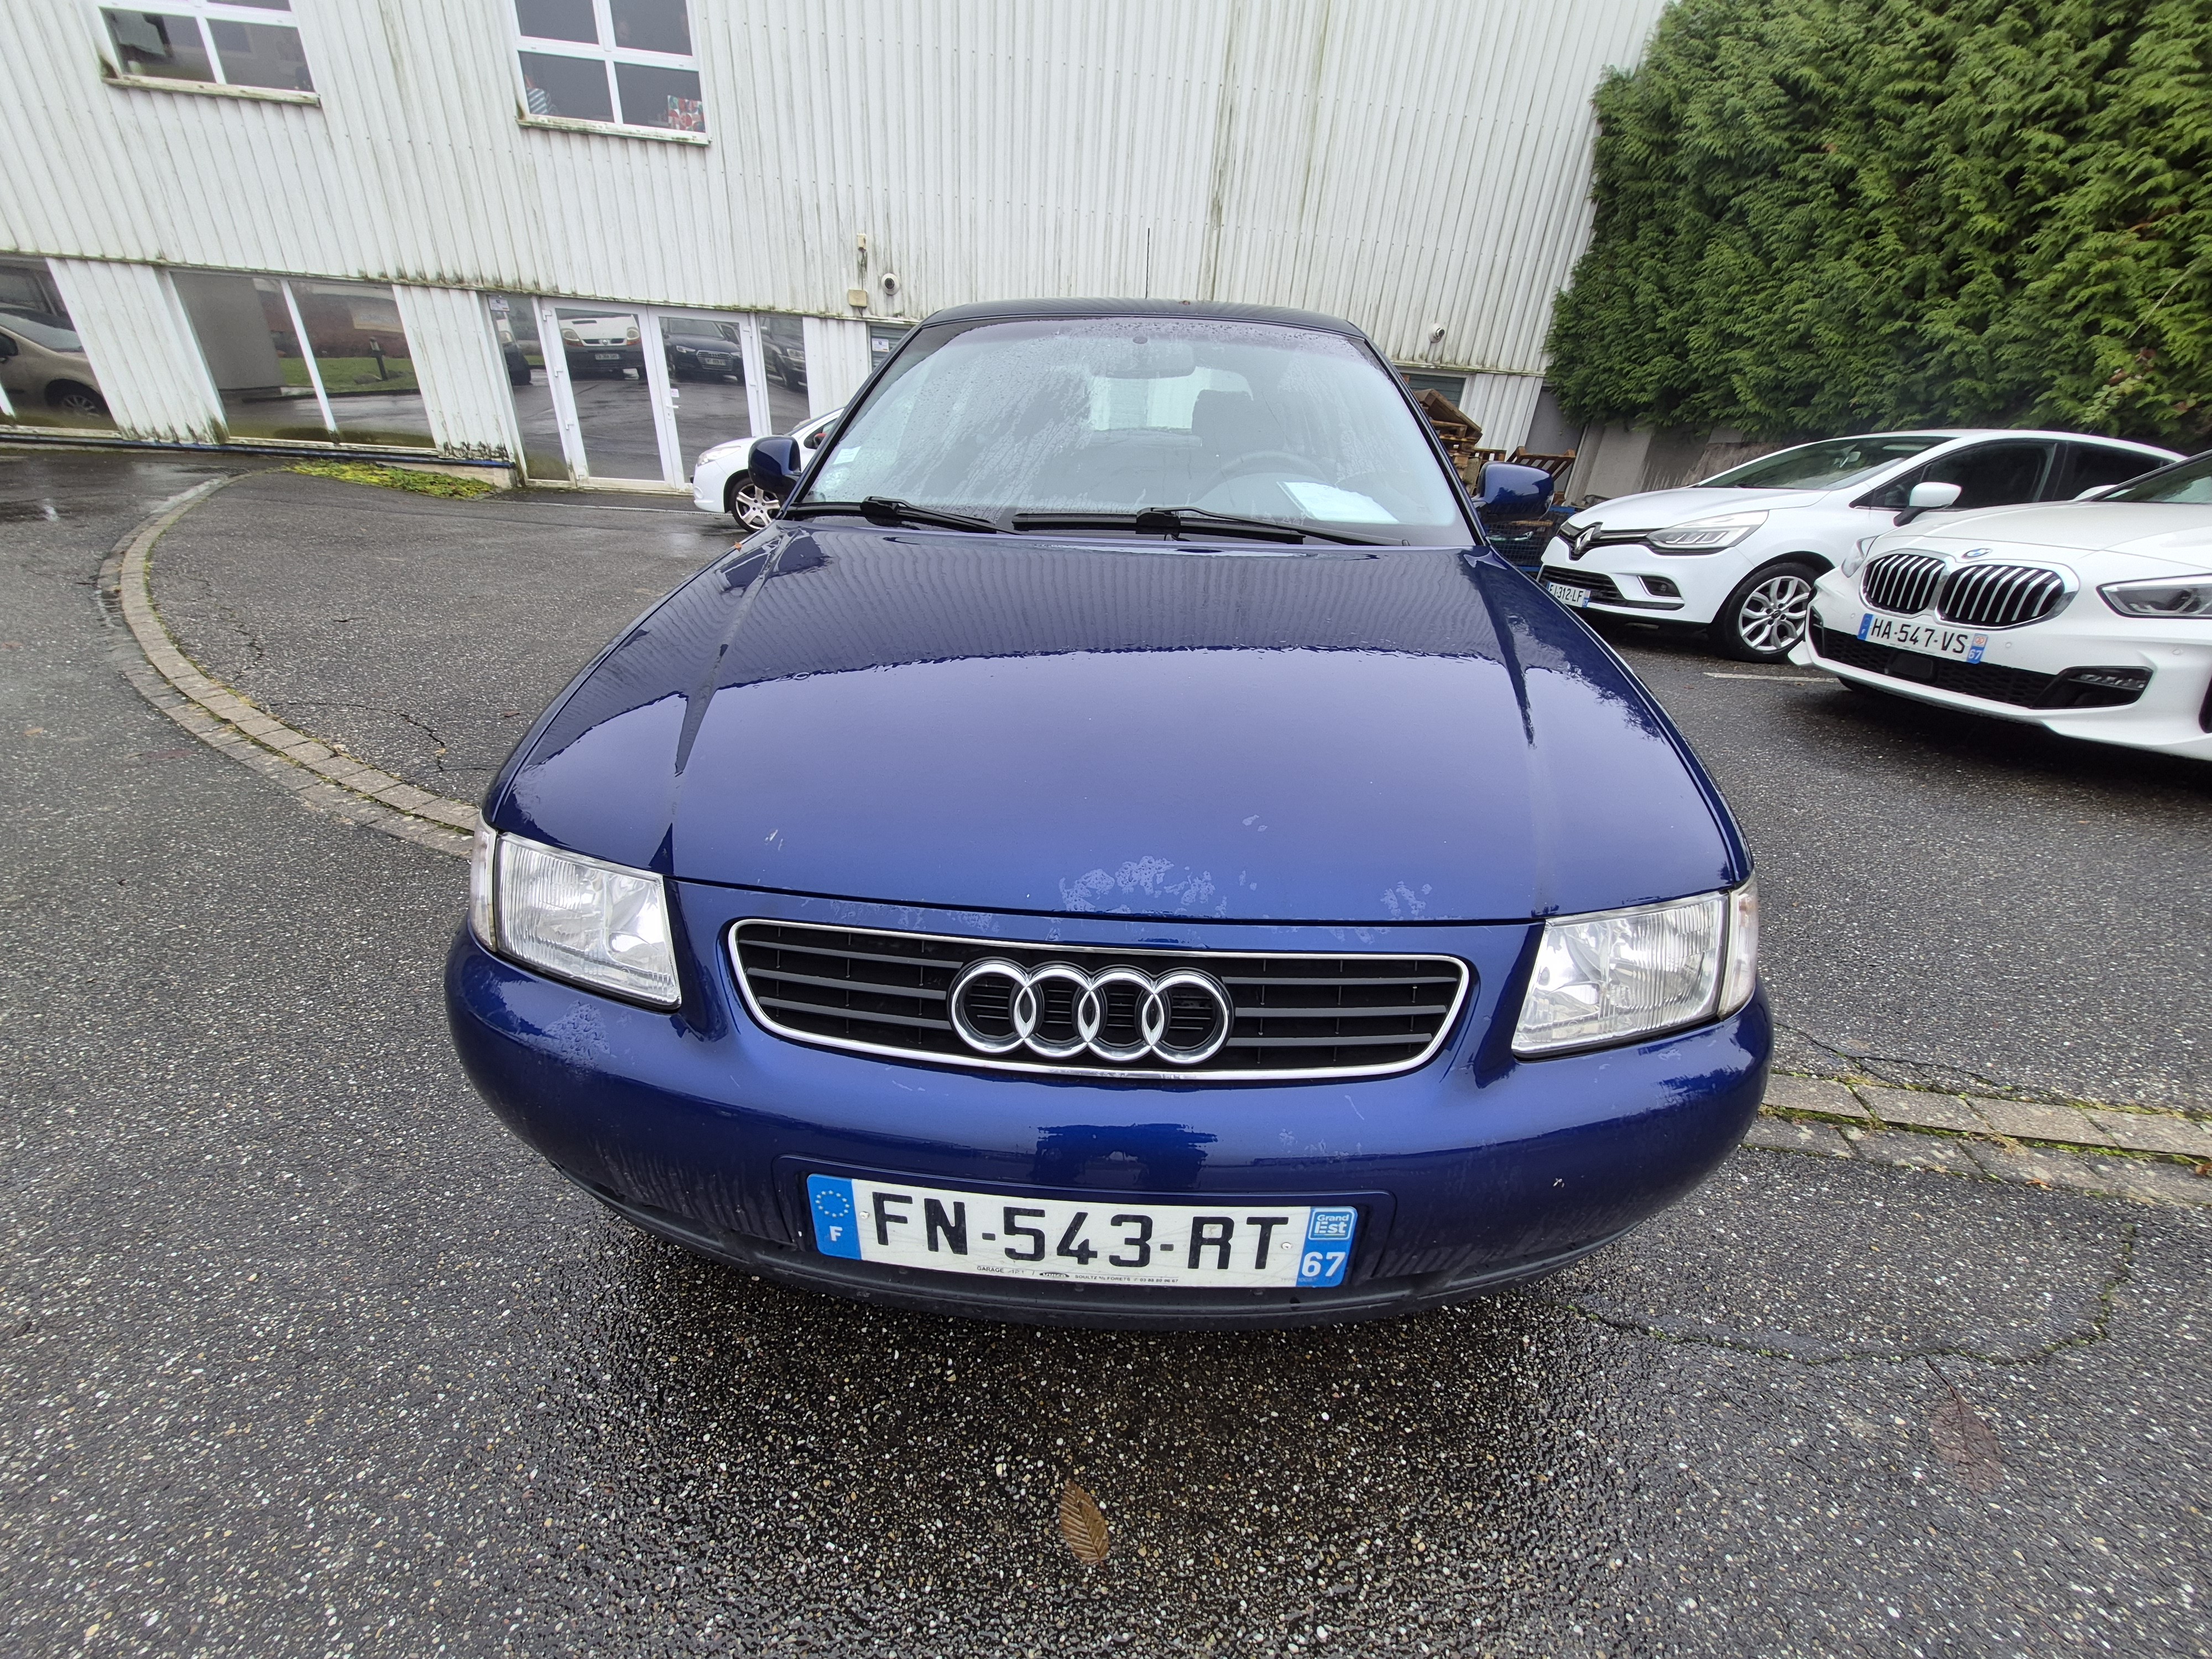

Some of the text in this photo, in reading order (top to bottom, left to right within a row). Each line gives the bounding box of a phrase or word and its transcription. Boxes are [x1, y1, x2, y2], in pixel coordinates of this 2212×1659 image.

[1870, 618, 1968, 653] HA-547-VS
[1969, 649, 1982, 659] 67
[830, 1226, 843, 1241] F
[873, 1192, 1289, 1270] FN-543-RT
[1314, 1221, 1347, 1234] Est
[1302, 1251, 1345, 1277] 67
